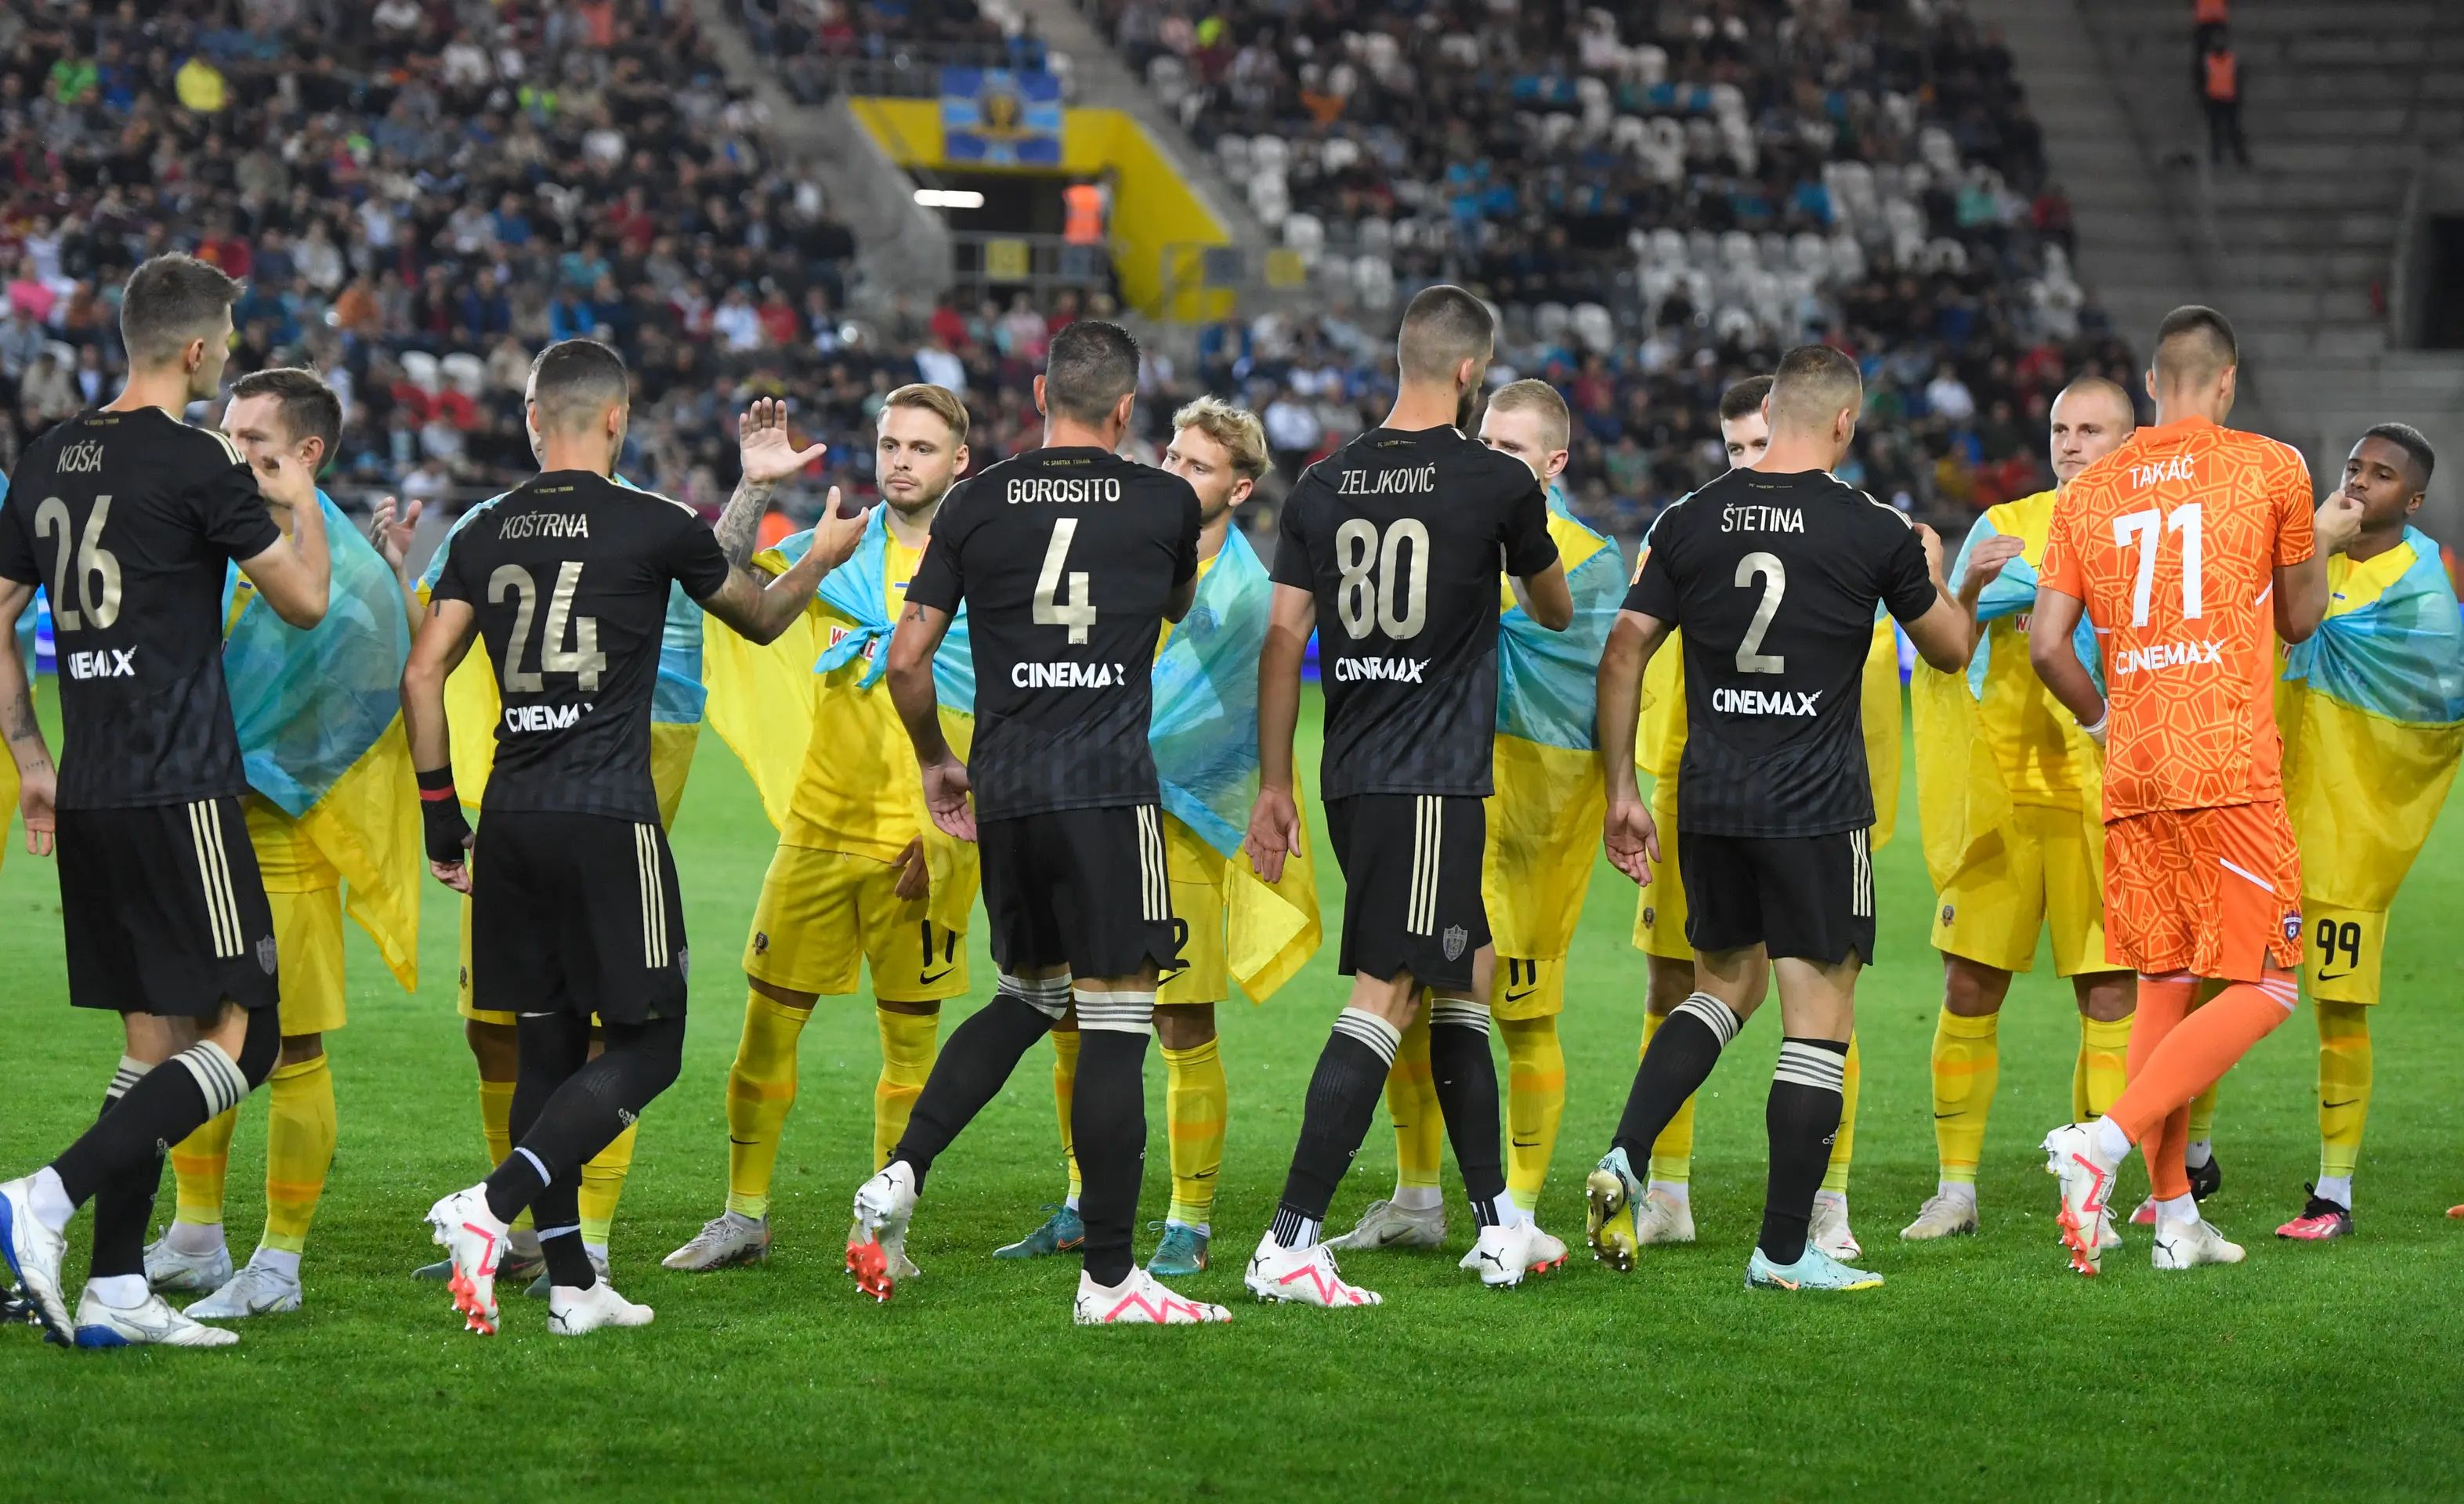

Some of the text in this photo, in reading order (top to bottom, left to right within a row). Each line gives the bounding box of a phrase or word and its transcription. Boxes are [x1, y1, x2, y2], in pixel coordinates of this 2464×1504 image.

[1337, 462, 1435, 495] ZELJKOVIĆ
[2129, 454, 2194, 490] TAKÁČ
[1007, 478, 1120, 504] GOROSITO
[498, 511, 589, 540] KOŠTRNA
[1720, 503, 1805, 533] ŠTETINA
[34, 495, 122, 631] 26
[1032, 518, 1096, 645] 4
[1335, 518, 1430, 640] 80
[2112, 503, 2202, 628] 71
[487, 561, 606, 692] 24
[1734, 551, 1786, 674] 2
[2115, 638, 2227, 675] CINEMAX
[505, 703, 593, 733] CINEMA
[1713, 688, 1822, 716] CINEMAX
[2316, 918, 2361, 969] 99
